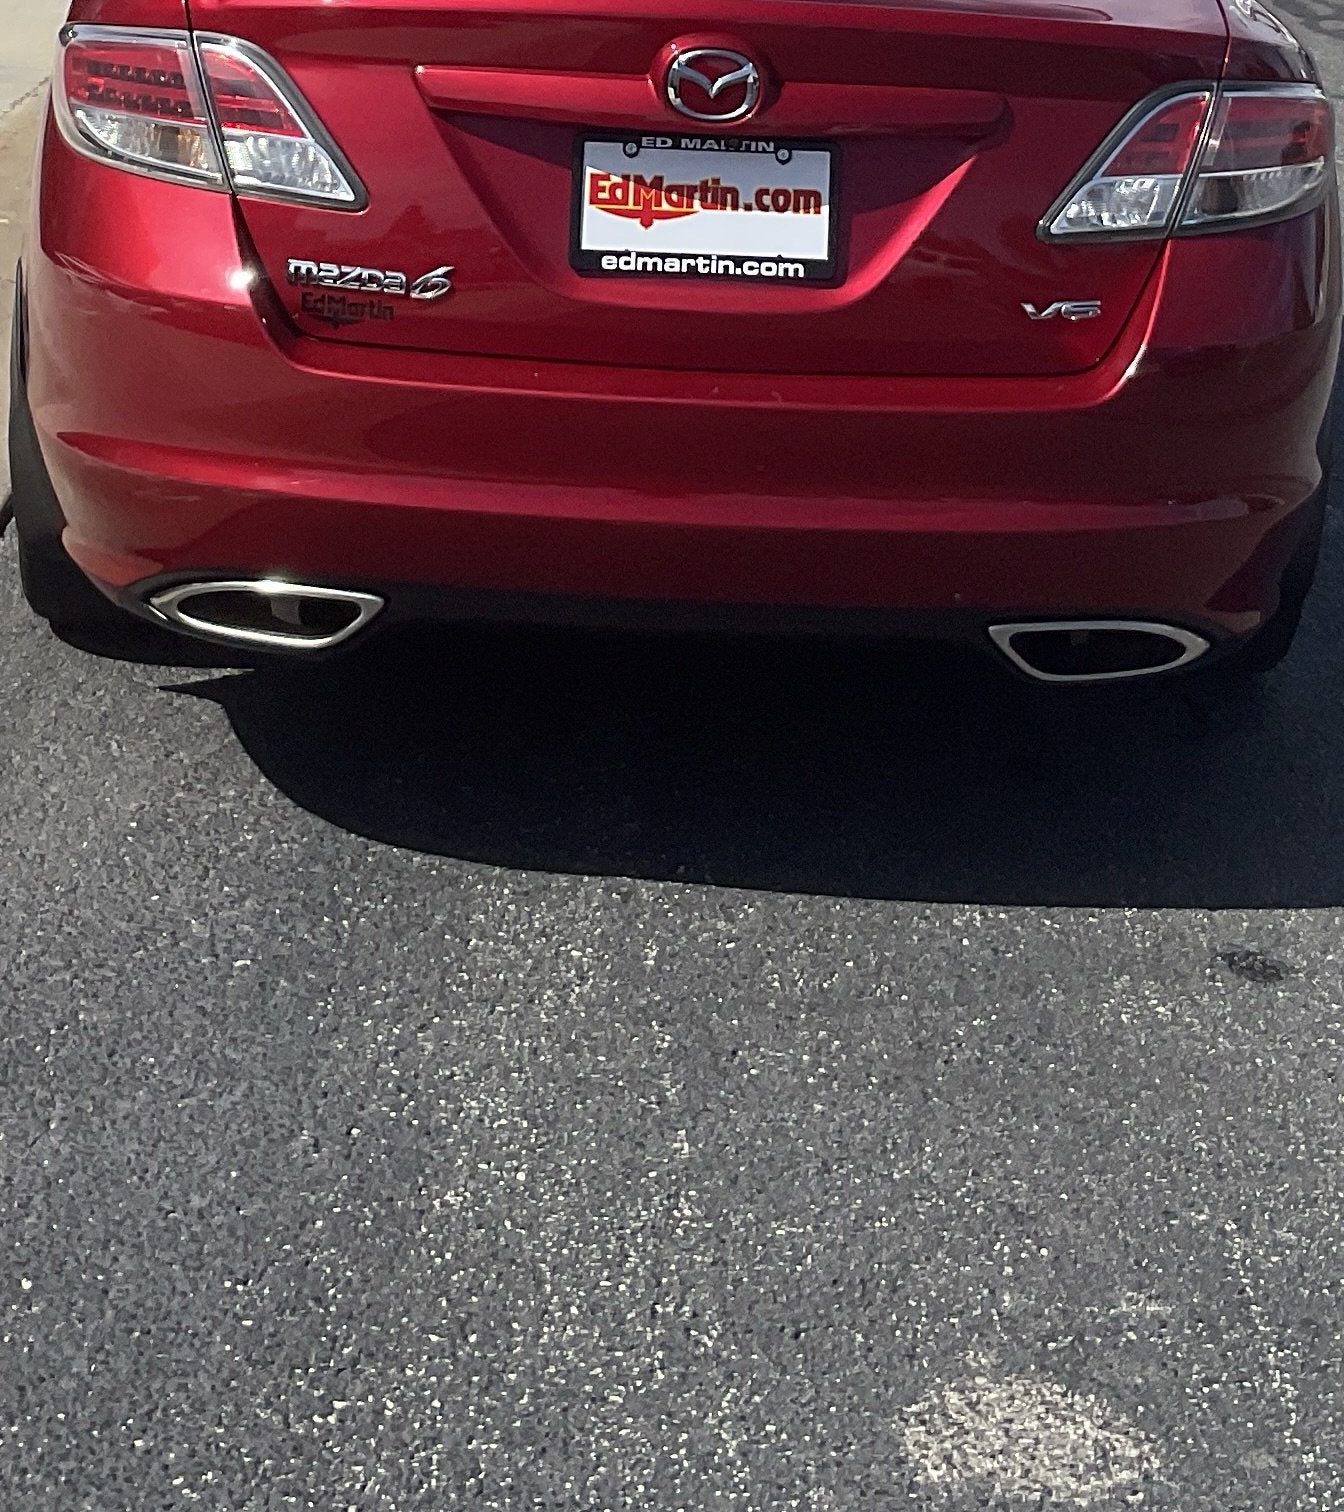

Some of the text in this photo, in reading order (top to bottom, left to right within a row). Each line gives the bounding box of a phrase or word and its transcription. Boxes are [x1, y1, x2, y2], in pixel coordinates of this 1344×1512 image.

[641, 137, 673, 148] ED
[589, 172, 822, 215] EdMartin.com
[601, 252, 805, 278] edmartin.com
[1020, 300, 1102, 320] V6
